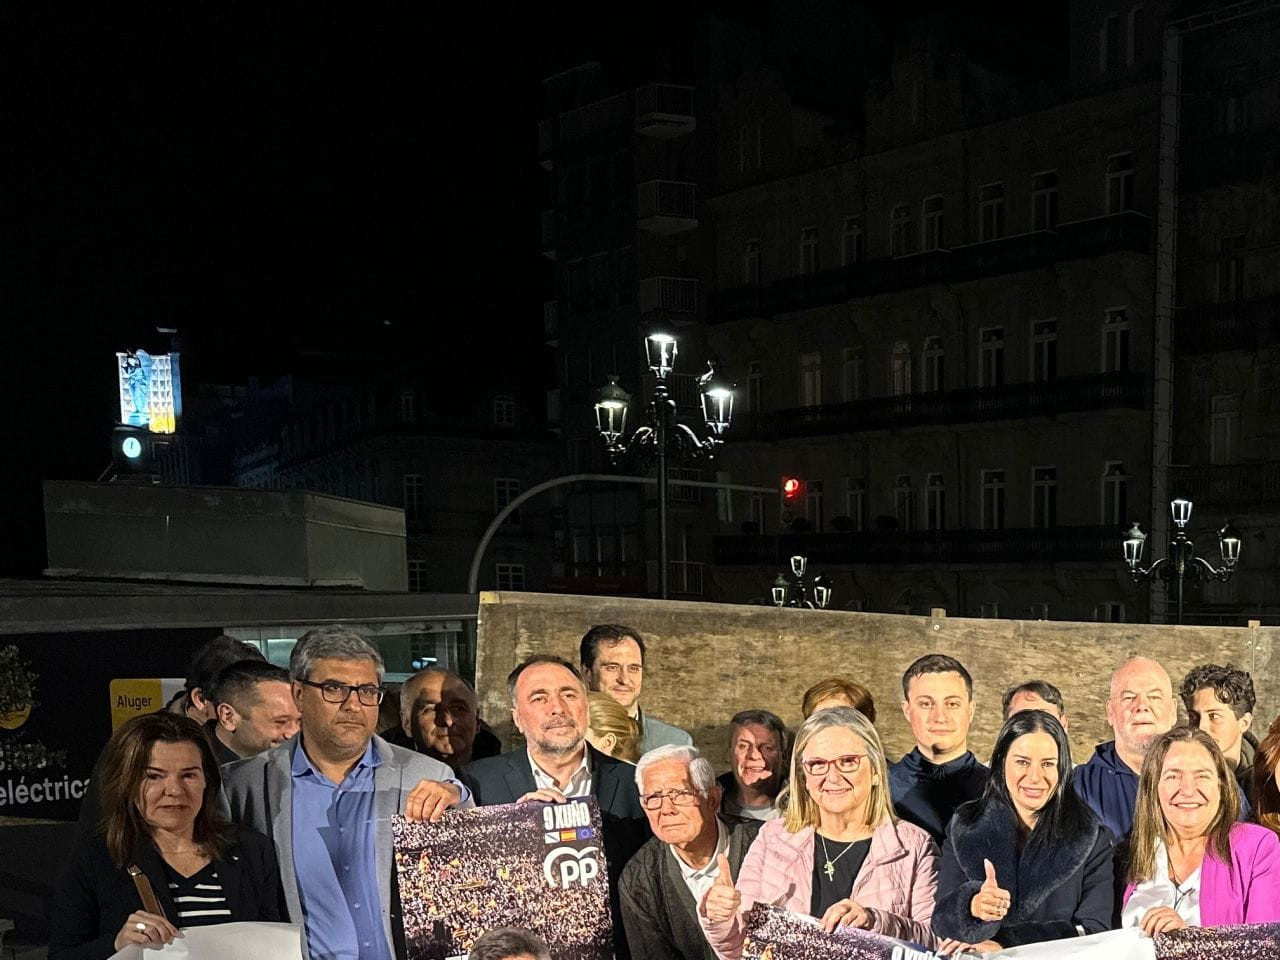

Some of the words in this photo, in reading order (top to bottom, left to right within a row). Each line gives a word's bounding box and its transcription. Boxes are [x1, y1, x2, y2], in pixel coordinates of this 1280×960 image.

[117, 695, 153, 710] Aluger
[543, 807, 554, 830] 9
[554, 800, 591, 829] XUÑO
